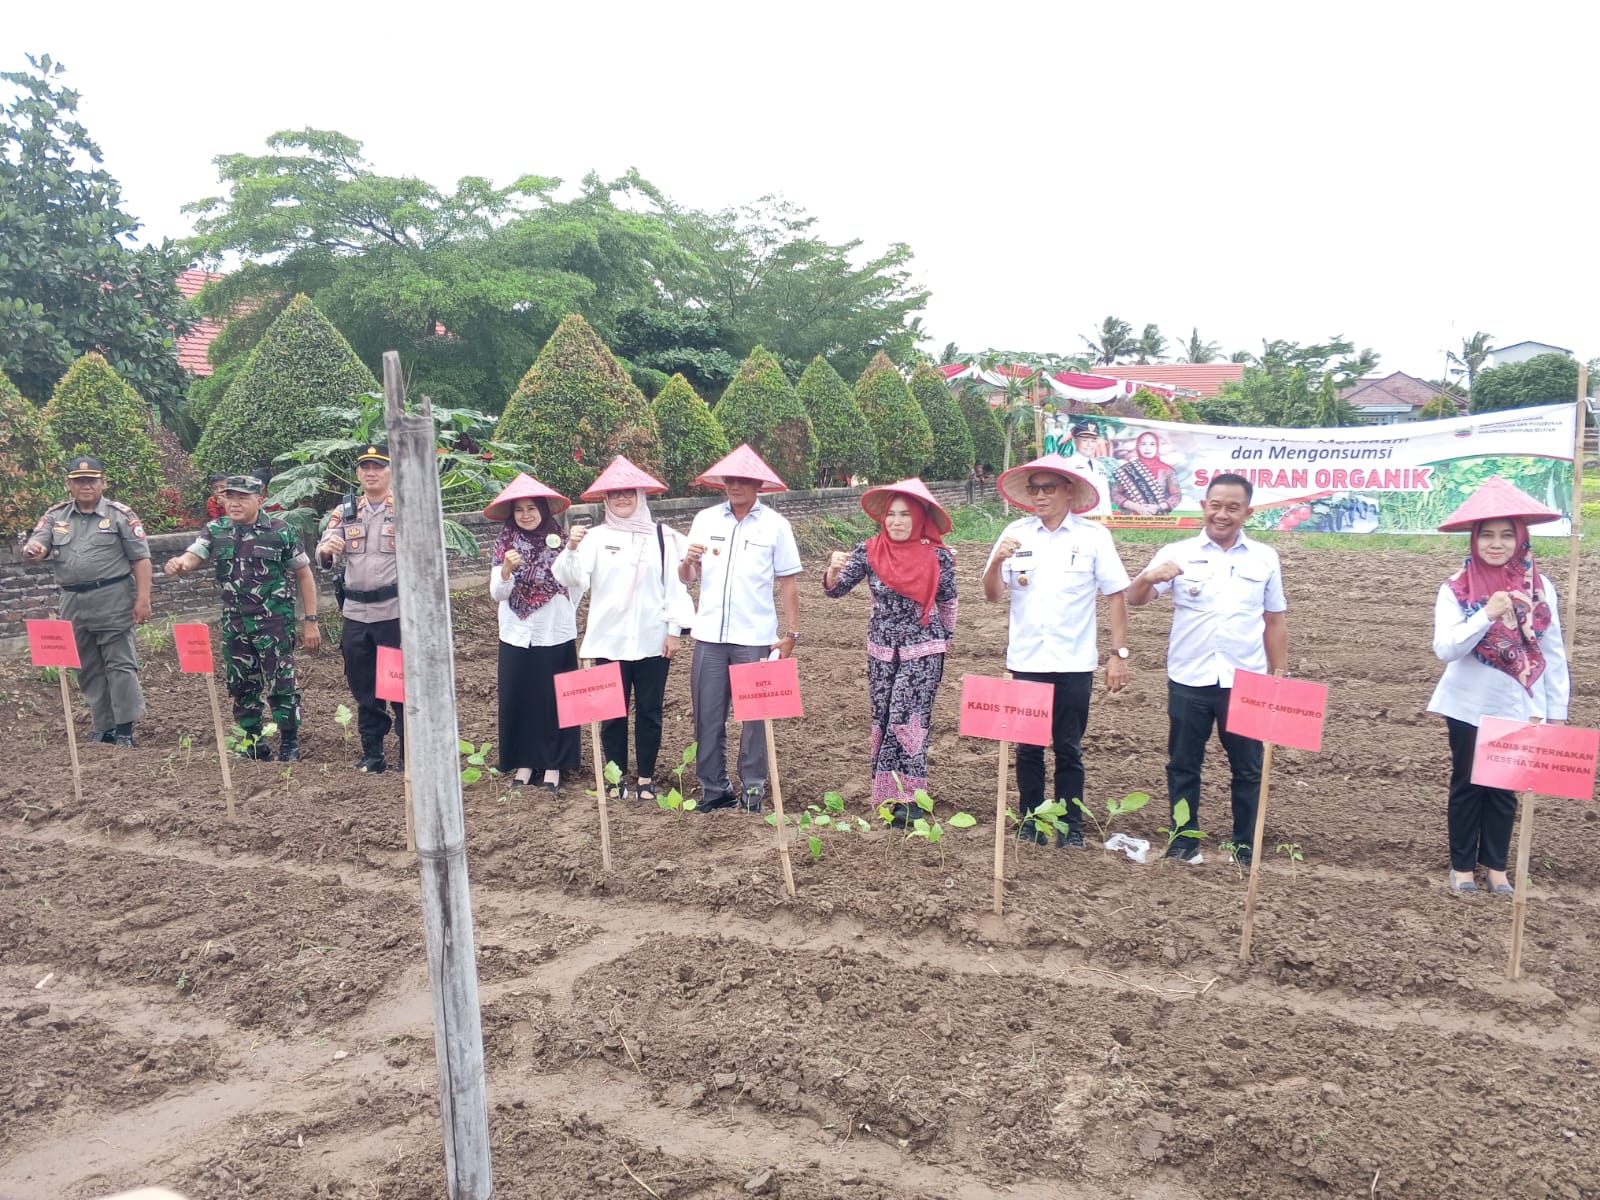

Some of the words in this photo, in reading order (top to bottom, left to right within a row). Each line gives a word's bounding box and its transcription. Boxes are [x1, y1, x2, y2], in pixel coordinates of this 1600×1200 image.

[1231, 445, 1263, 460] dan
[1268, 445, 1394, 463] Mengonsumsi
[1315, 468, 1431, 489] ORGANIK
[562, 687, 587, 697] ASISTEN
[967, 701, 1000, 713] KADIS
[1003, 705, 1049, 719] TPHBUN
[1240, 696, 1267, 707] CAMAT
[1268, 703, 1322, 719] CANDIPURO
[1488, 740, 1519, 751] KADIS
[1521, 745, 1594, 761] PETERNAKAN
[1486, 754, 1549, 770] KESEHATAN
[1551, 763, 1591, 775] HEWAN
